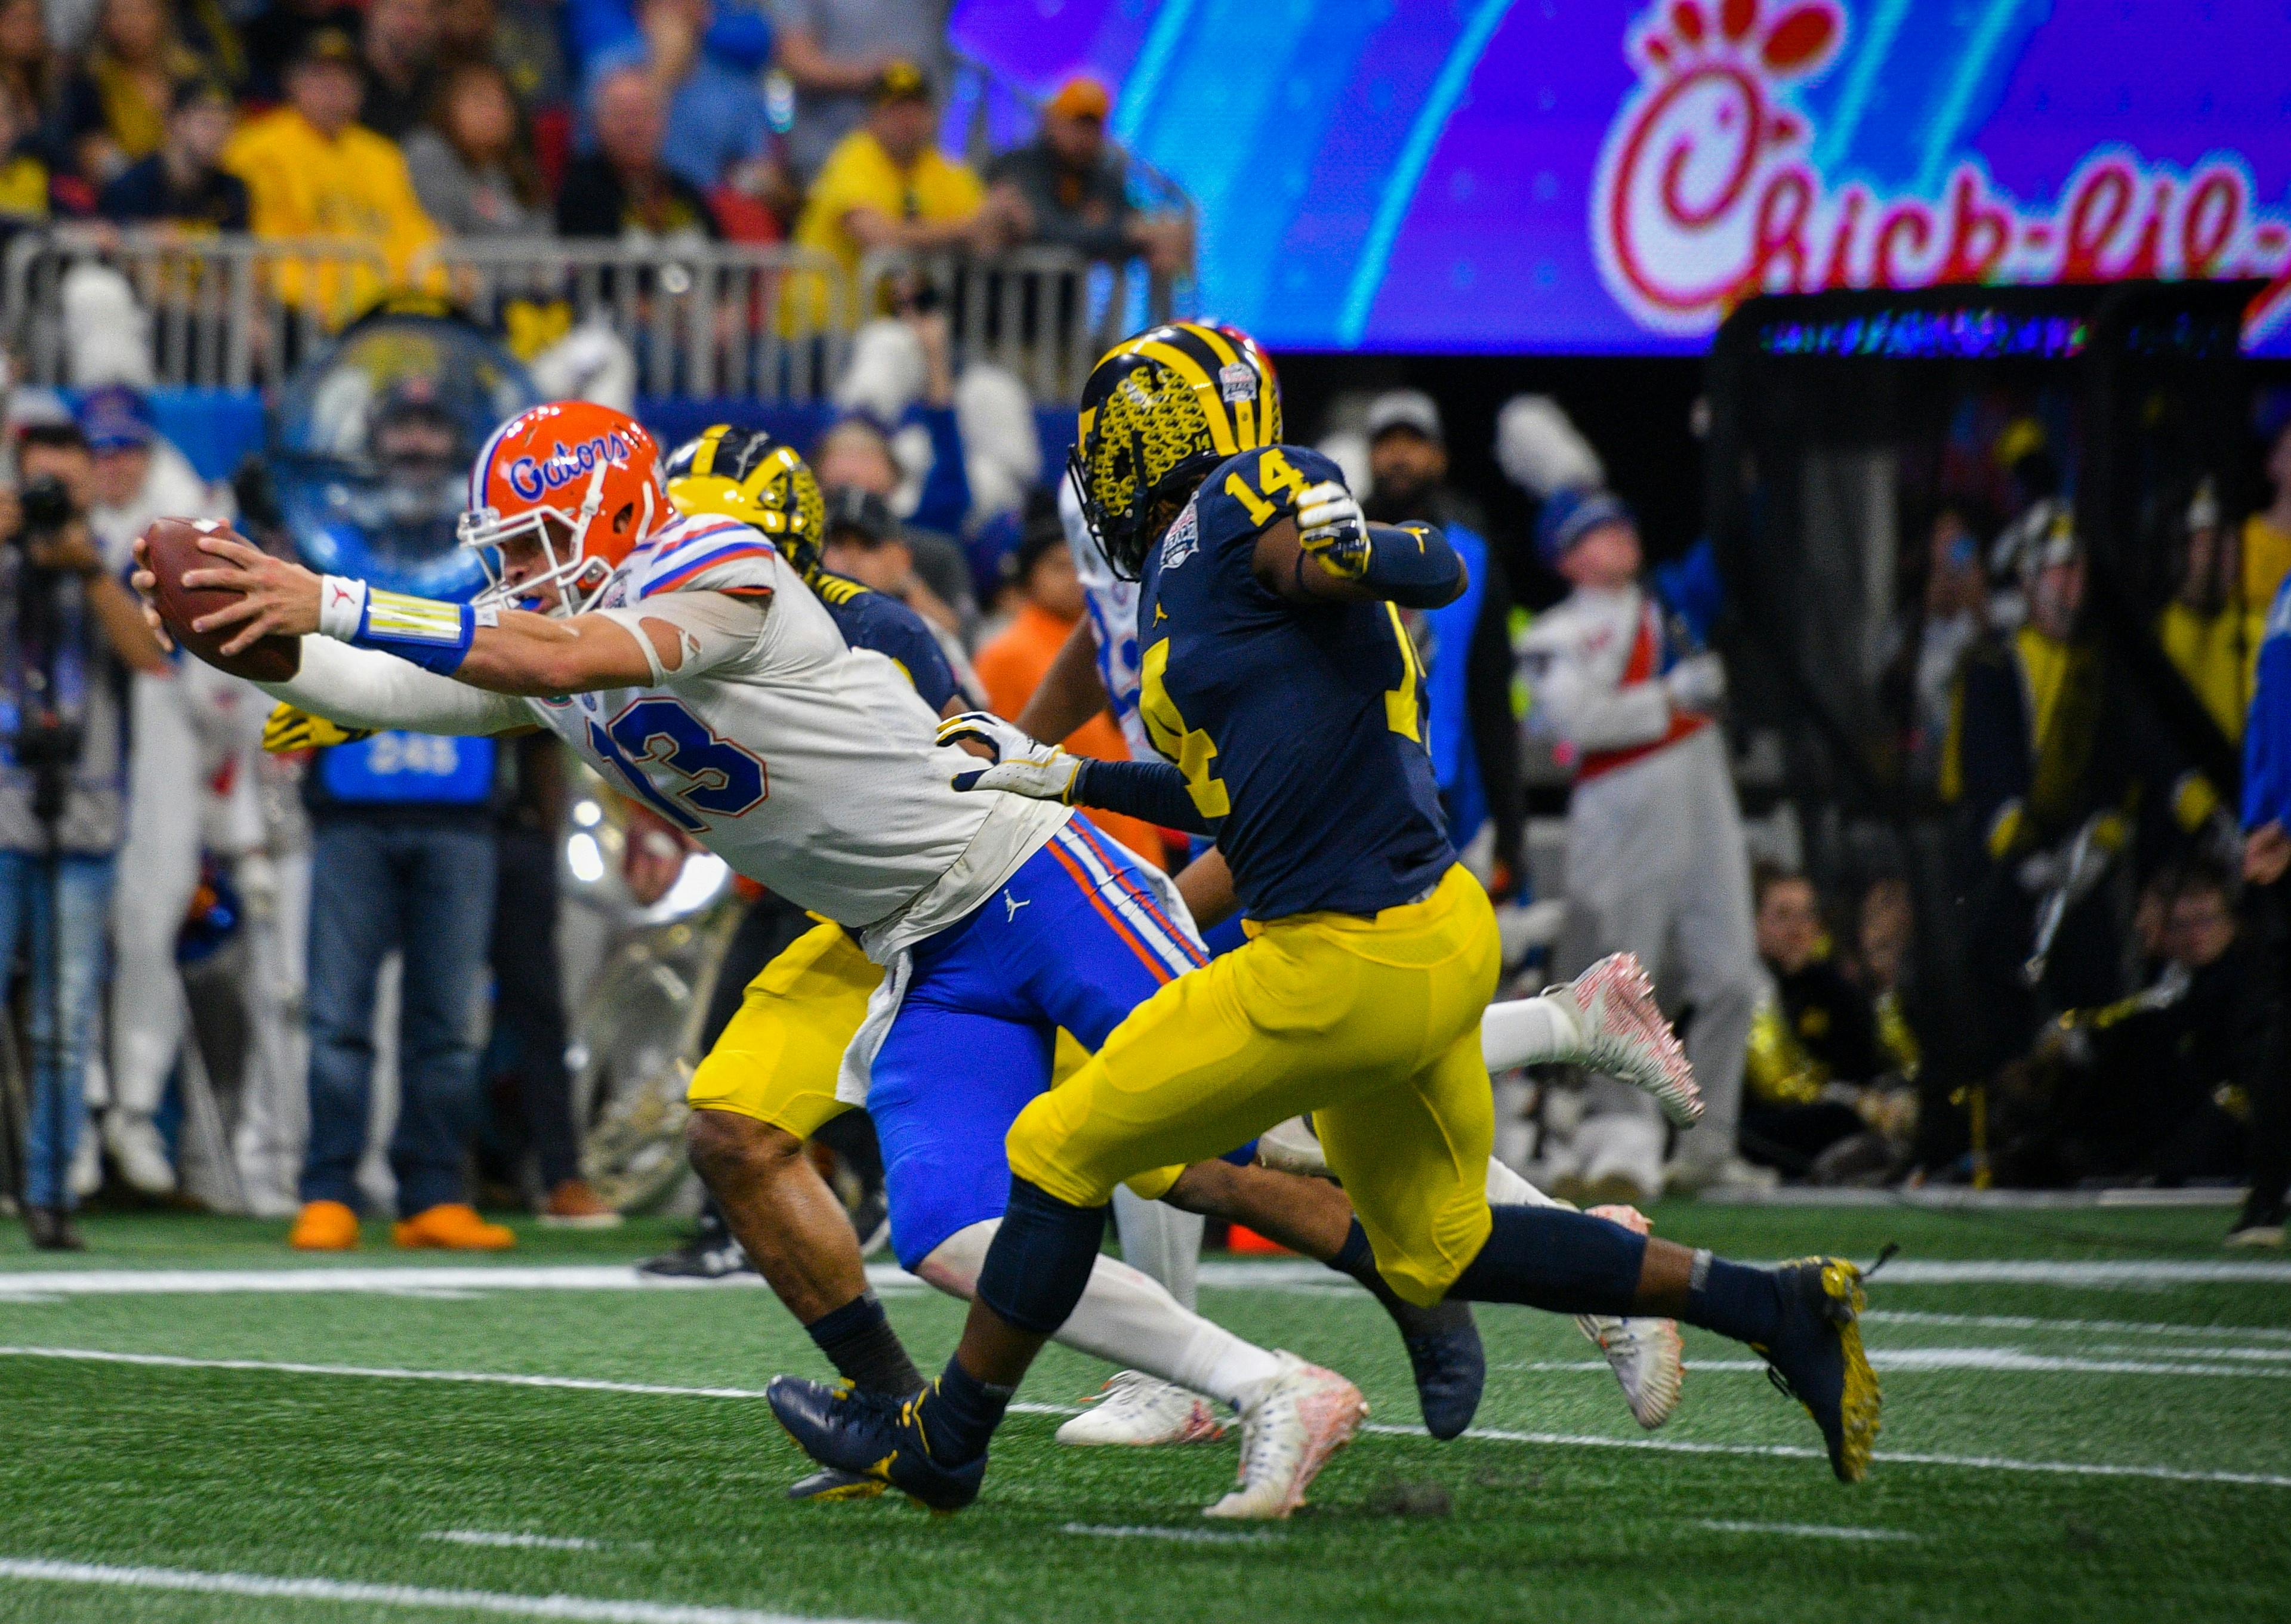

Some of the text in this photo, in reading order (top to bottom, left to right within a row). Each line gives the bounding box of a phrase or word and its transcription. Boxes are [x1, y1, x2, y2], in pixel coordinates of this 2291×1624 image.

[1604, 24, 2291, 325] Chick-fil-
[510, 431, 630, 502] Gators
[1194, 433, 1211, 451] 14
[1225, 447, 1312, 527] 14
[585, 695, 769, 833] 13
